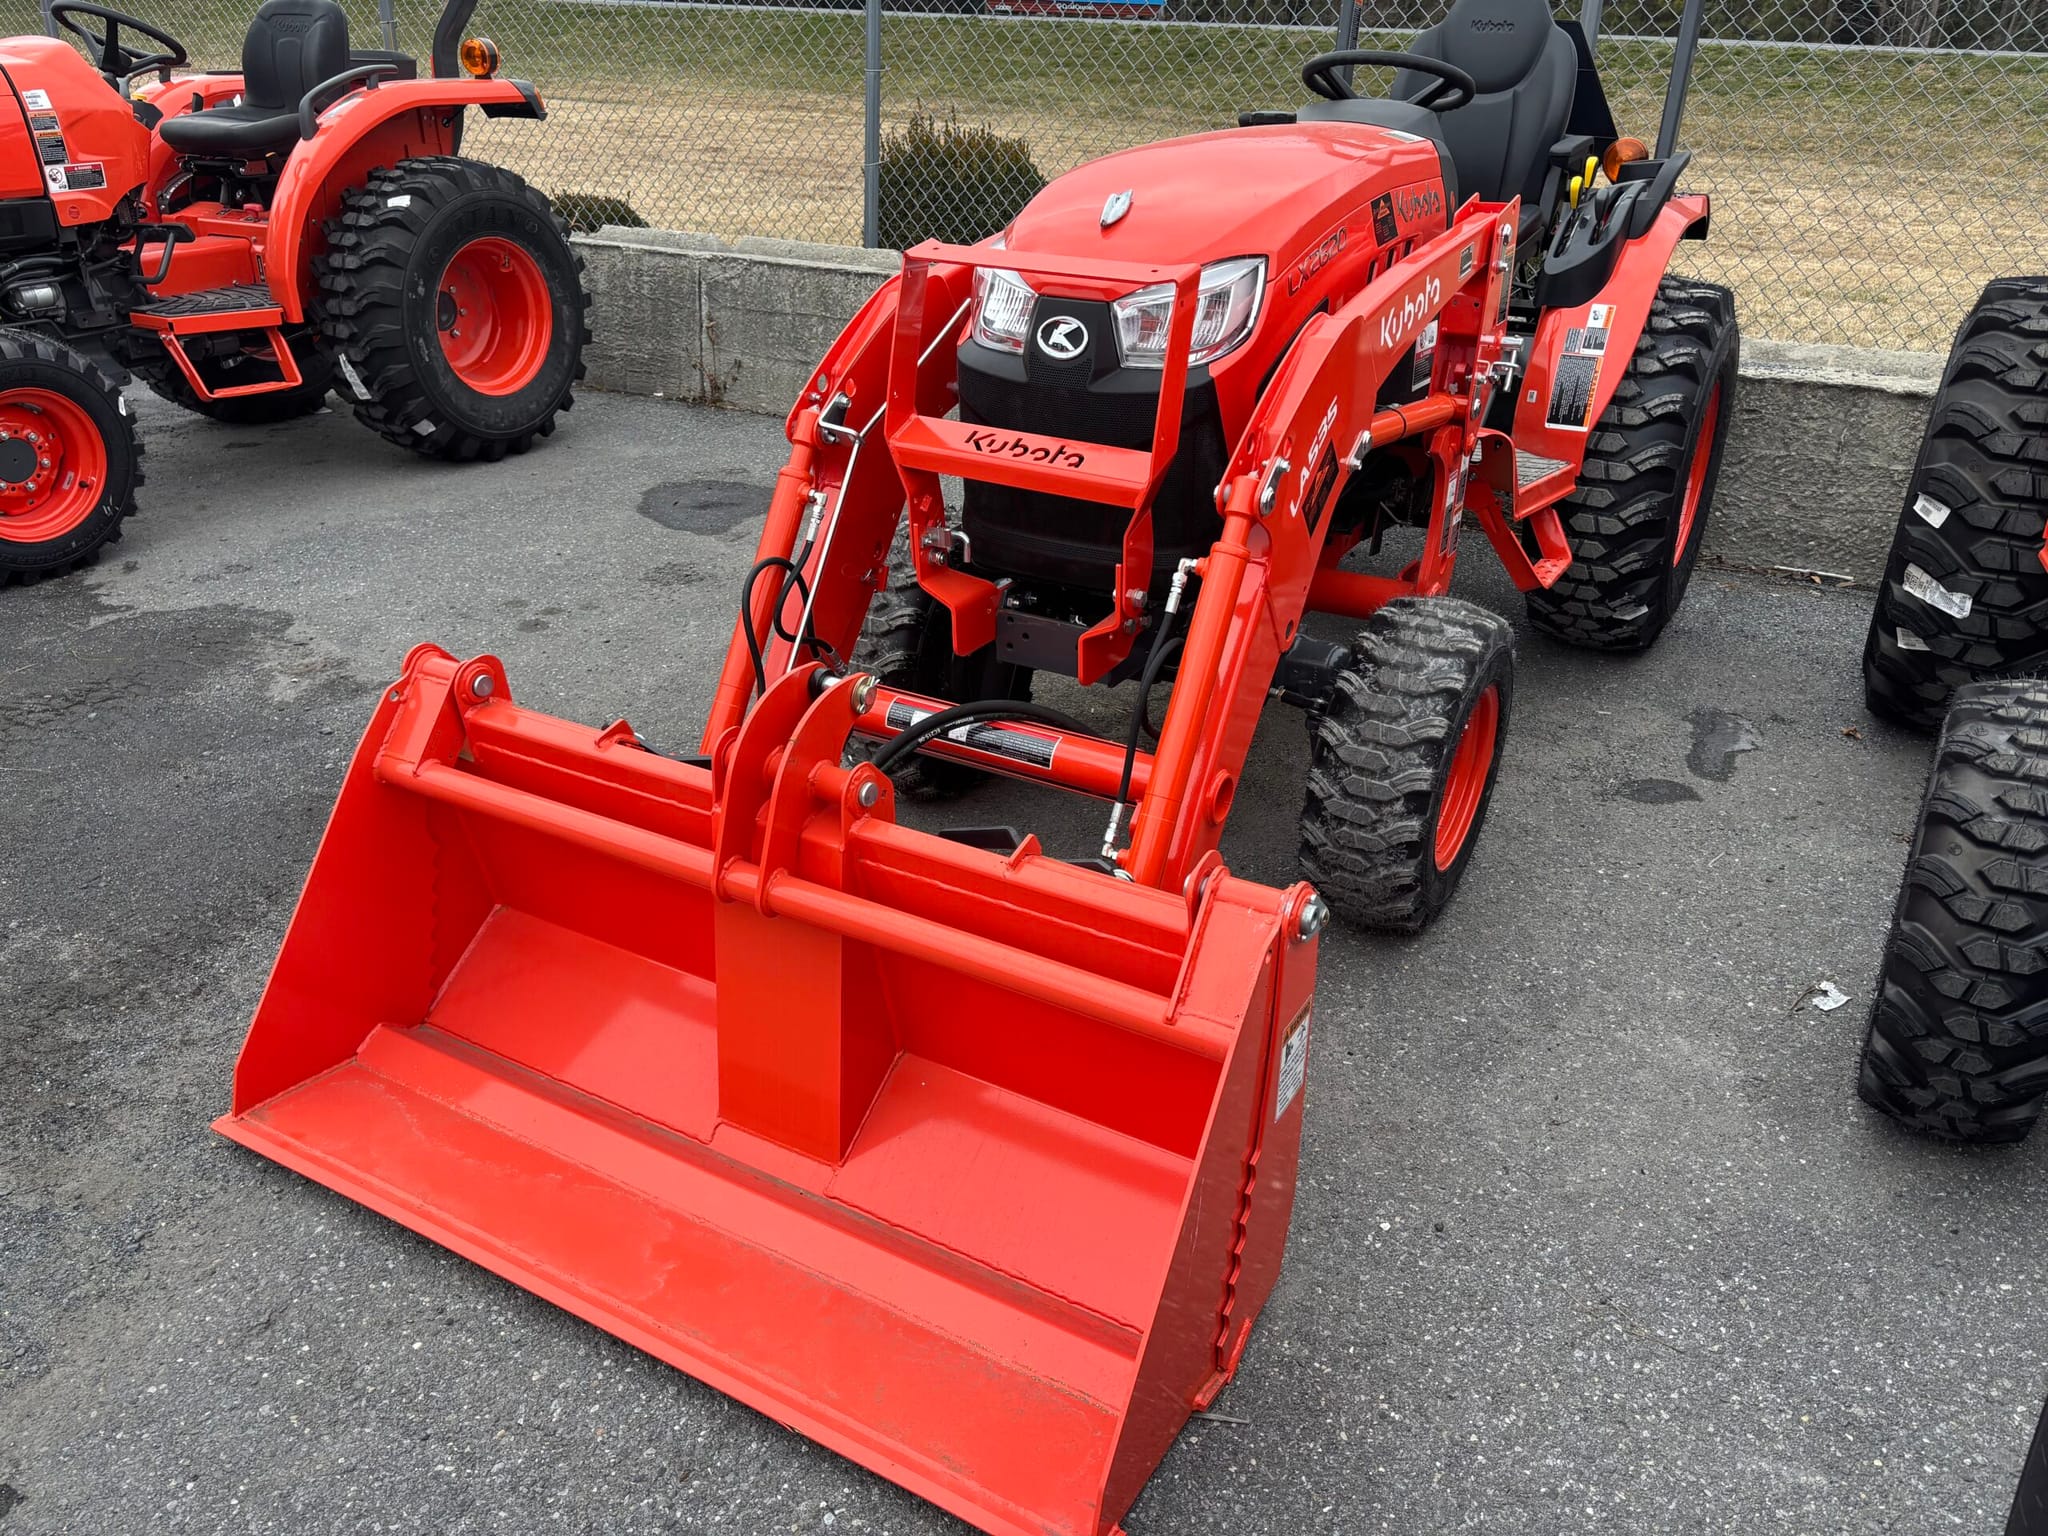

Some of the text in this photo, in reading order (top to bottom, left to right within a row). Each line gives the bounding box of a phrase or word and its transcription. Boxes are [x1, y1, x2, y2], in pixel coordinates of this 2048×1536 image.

[1470, 19, 1515, 31] Kubota
[1395, 185, 1440, 223] Kubota
[1288, 226, 1347, 297] LX2620
[1380, 274, 1440, 349] Kubota
[964, 430, 1085, 469] Kubota
[1290, 395, 1338, 518] LA535
